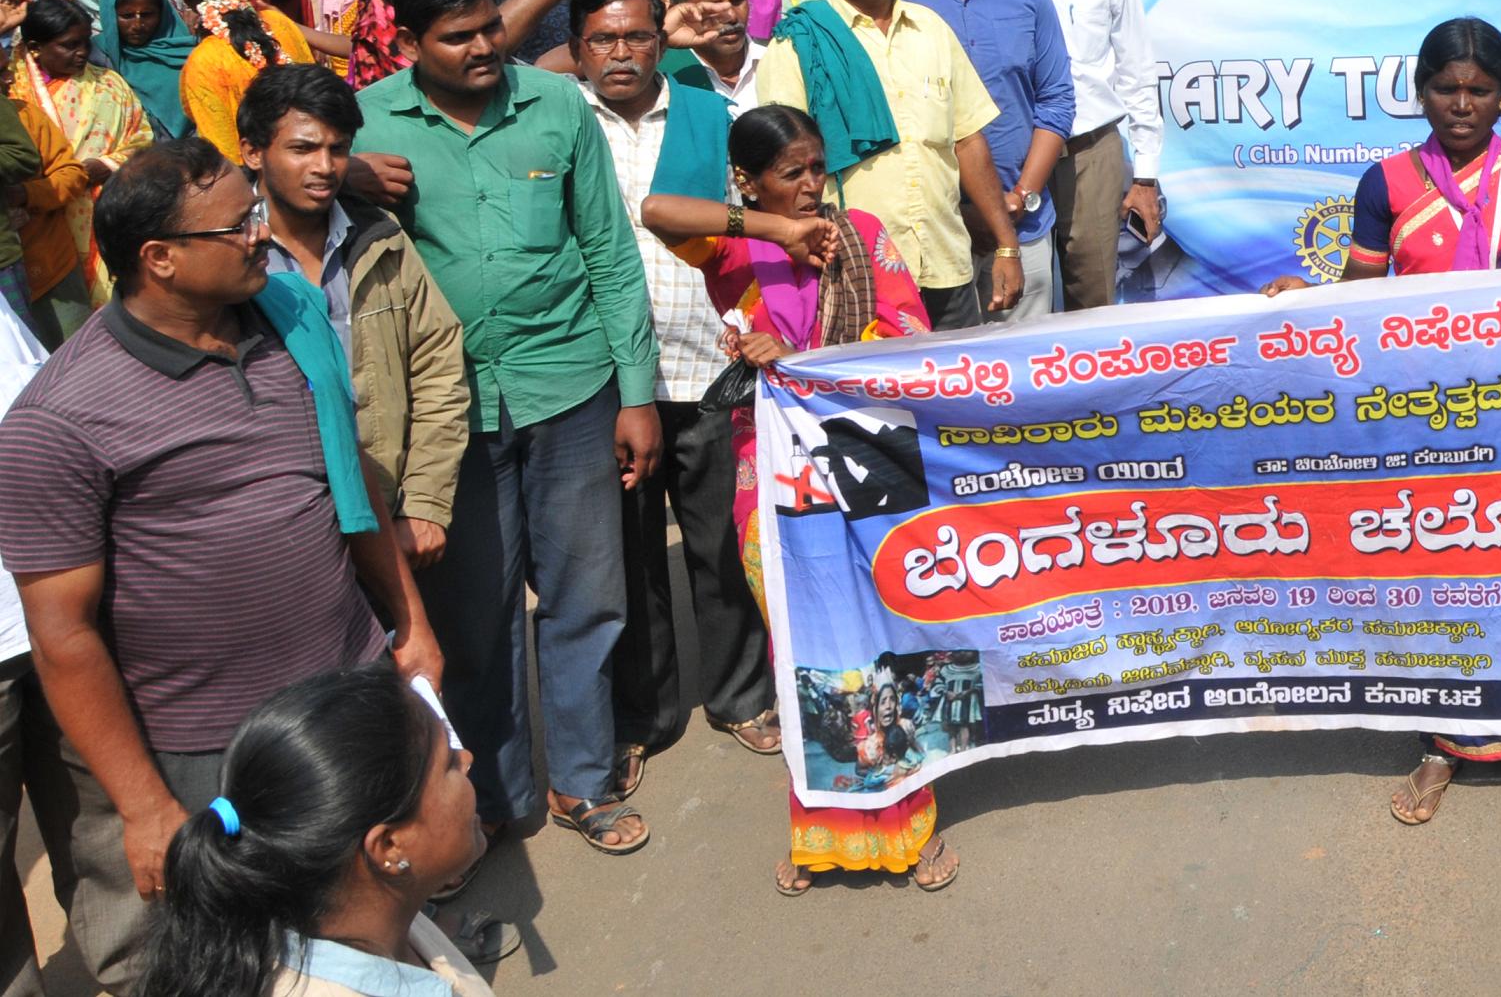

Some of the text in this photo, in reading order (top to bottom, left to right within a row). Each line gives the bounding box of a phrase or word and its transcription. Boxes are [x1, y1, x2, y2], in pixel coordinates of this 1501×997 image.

[1249, 144, 1298, 165] Club
[1304, 141, 1394, 164] Number
[1322, 204, 1355, 217] ROTAR
[1029, 336, 1239, 391] ಸಂಪೂರ್ಣ
[1259, 317, 1361, 377] ಮದ್ಯ
[938, 410, 1119, 447] ಸಾವಿರಾರು
[1139, 390, 1334, 434] ಮಹಿಳೆಯರ
[1097, 454, 1186, 482] ಯಿಂದ
[1413, 444, 1496, 466] ಕಲಬುರಗಿ
[903, 495, 1310, 600] ಬೆಂಗಳೂರು
[998, 598, 1105, 644] ಪಾದಯಾತ್ರೆ
[1208, 585, 1278, 610] ಜನವರಿ
[1286, 585, 1317, 609] 19
[1326, 584, 1377, 608] ರಿಂದ
[1386, 584, 1422, 609] 30
[1017, 634, 1108, 669] ಸಮಾಜದ
[1234, 616, 1354, 641] ಆರೋಗ್ಯಕರ
[1244, 649, 1307, 674] ವ್ಯಸನ
[1315, 648, 1366, 671] ಮುಕ್ತ
[1374, 651, 1492, 677] ಸಮಾಜಕ್ಕಾಗಿ
[1027, 699, 1096, 731] ಮದ್ಯ
[1203, 681, 1352, 708] ಆಂದೋಲನ
[1364, 682, 1483, 708] ಕರ್ನಾಟಕ
